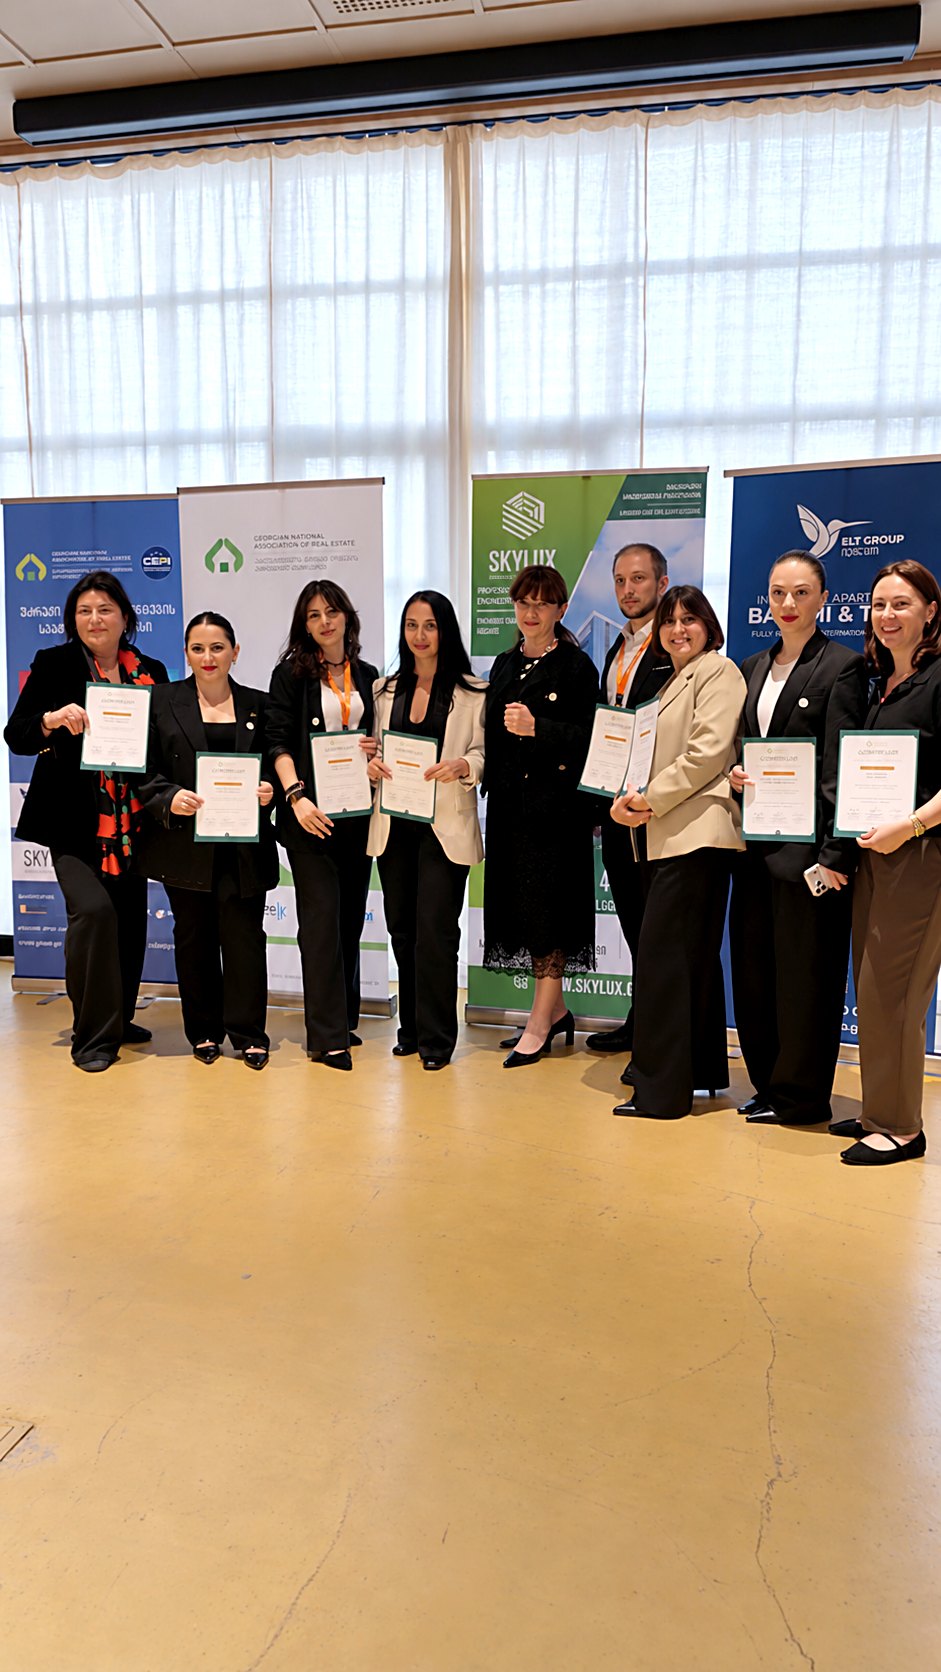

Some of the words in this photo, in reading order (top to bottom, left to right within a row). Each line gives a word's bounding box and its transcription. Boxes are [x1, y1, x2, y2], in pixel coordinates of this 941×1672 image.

[330, 539, 355, 547] ESTATE
[841, 536, 862, 546] ELT
[863, 534, 905, 545] GROUP
[142, 556, 171, 566] CEPI
[489, 549, 557, 572] SKYLUX
[832, 592, 871, 603] APART
[838, 605, 854, 623] &
[751, 630, 773, 638] FULLY
[23, 850, 54, 867] SKY
[562, 977, 633, 997] W.SKYLUX.G
